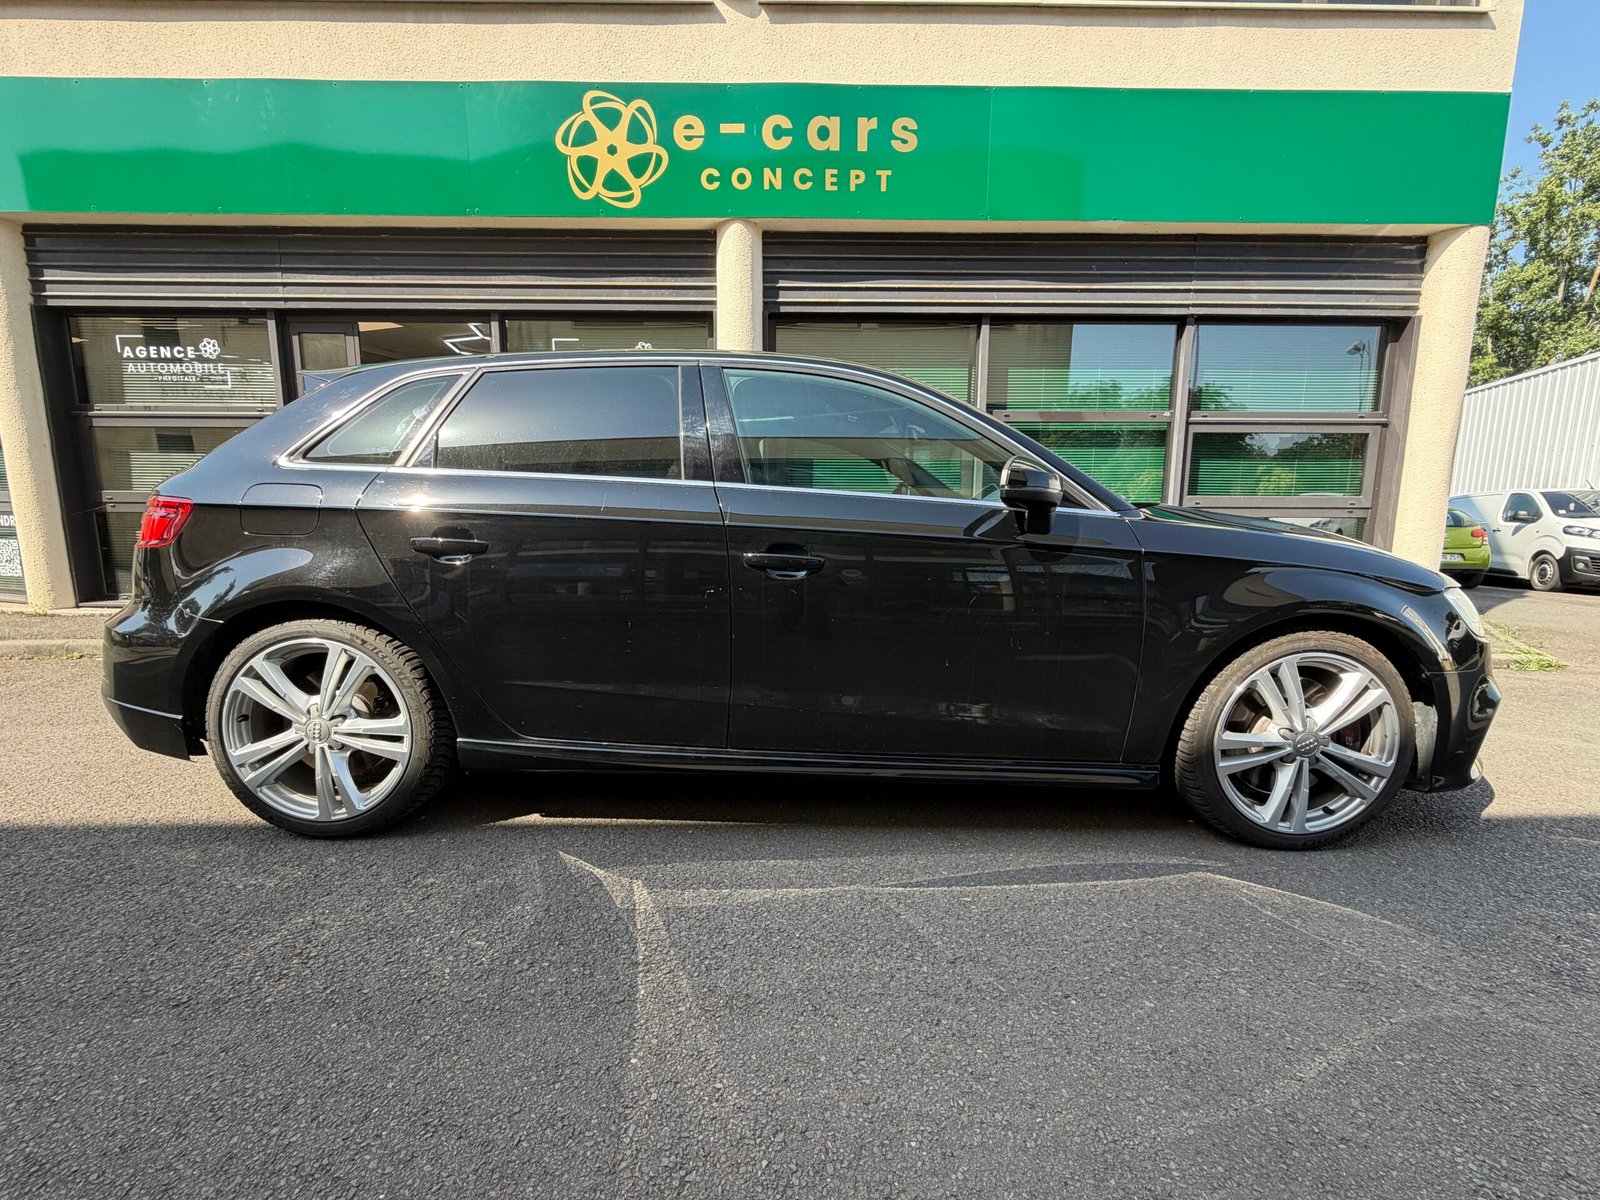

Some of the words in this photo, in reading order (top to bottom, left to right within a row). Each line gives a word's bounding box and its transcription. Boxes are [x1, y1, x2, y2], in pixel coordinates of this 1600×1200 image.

[673, 114, 919, 153] e-cars
[700, 167, 892, 192] CONCEPT
[122, 345, 196, 358] AGENCE
[127, 362, 226, 374] AUTOMOBILE
